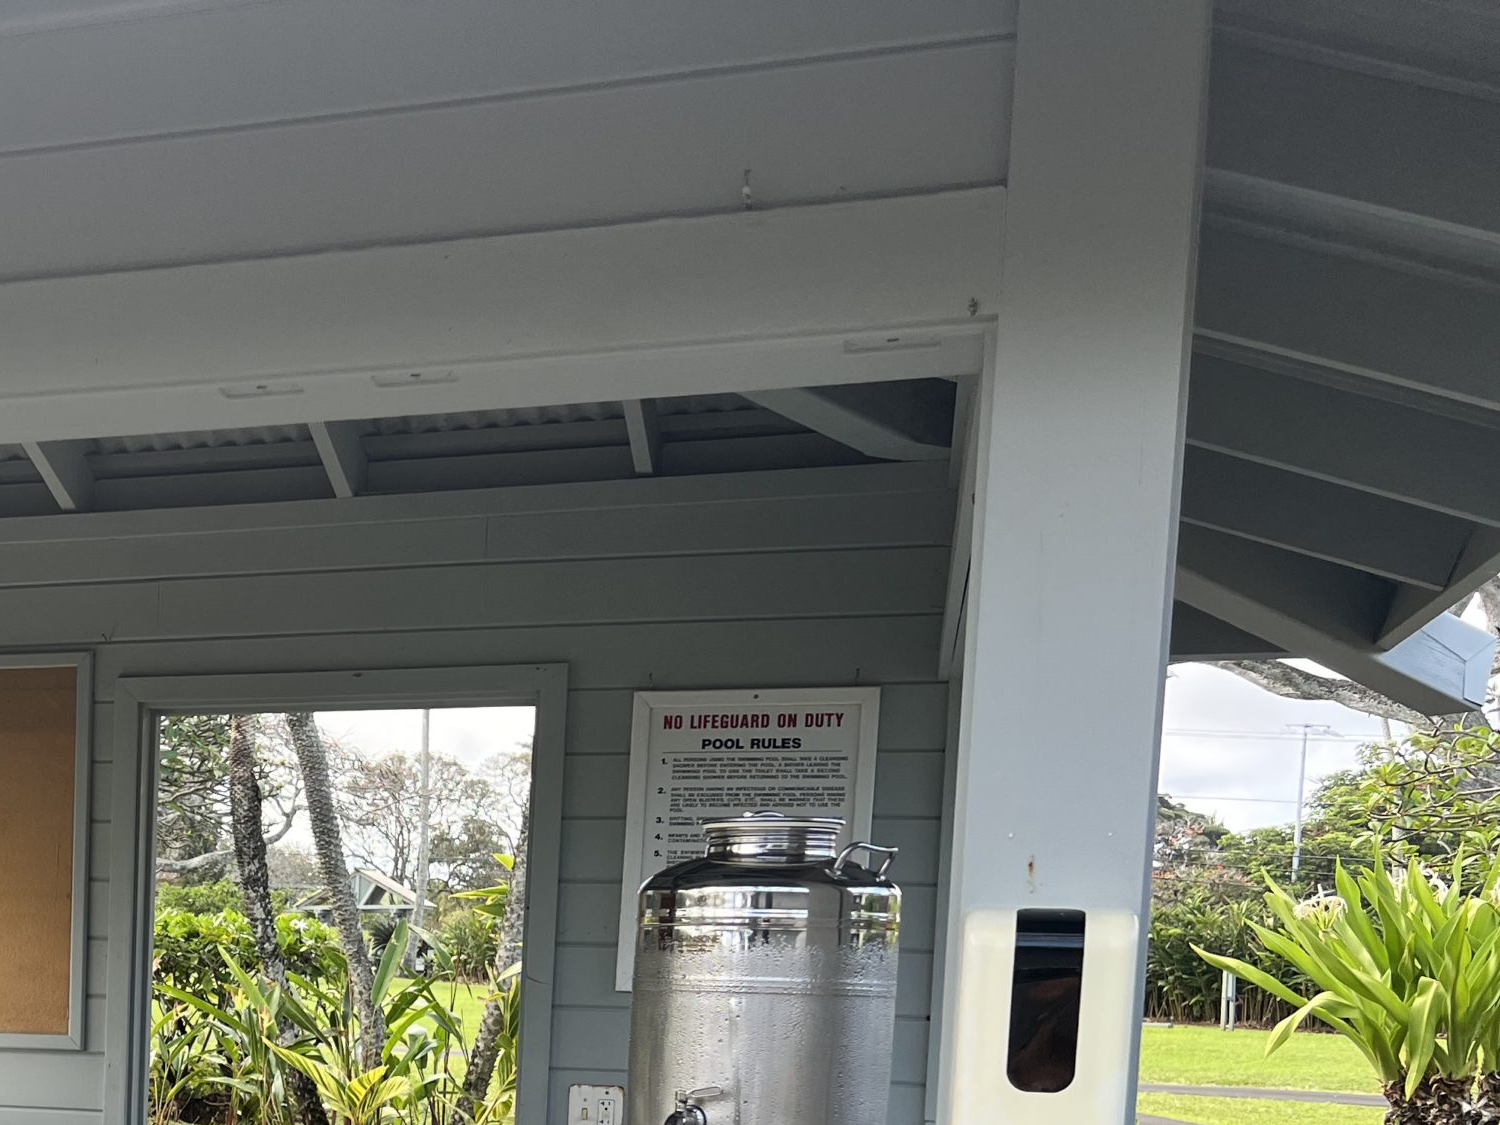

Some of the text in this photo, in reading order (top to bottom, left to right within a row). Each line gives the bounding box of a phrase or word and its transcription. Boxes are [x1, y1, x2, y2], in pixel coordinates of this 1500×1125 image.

[663, 712, 844, 729] NO LIFEGUARD ON DUTY
[701, 738, 802, 750] POOL RULES
[661, 758, 668, 766] 1.
[656, 816, 664, 824] 3.
[654, 849, 662, 857] 5.
